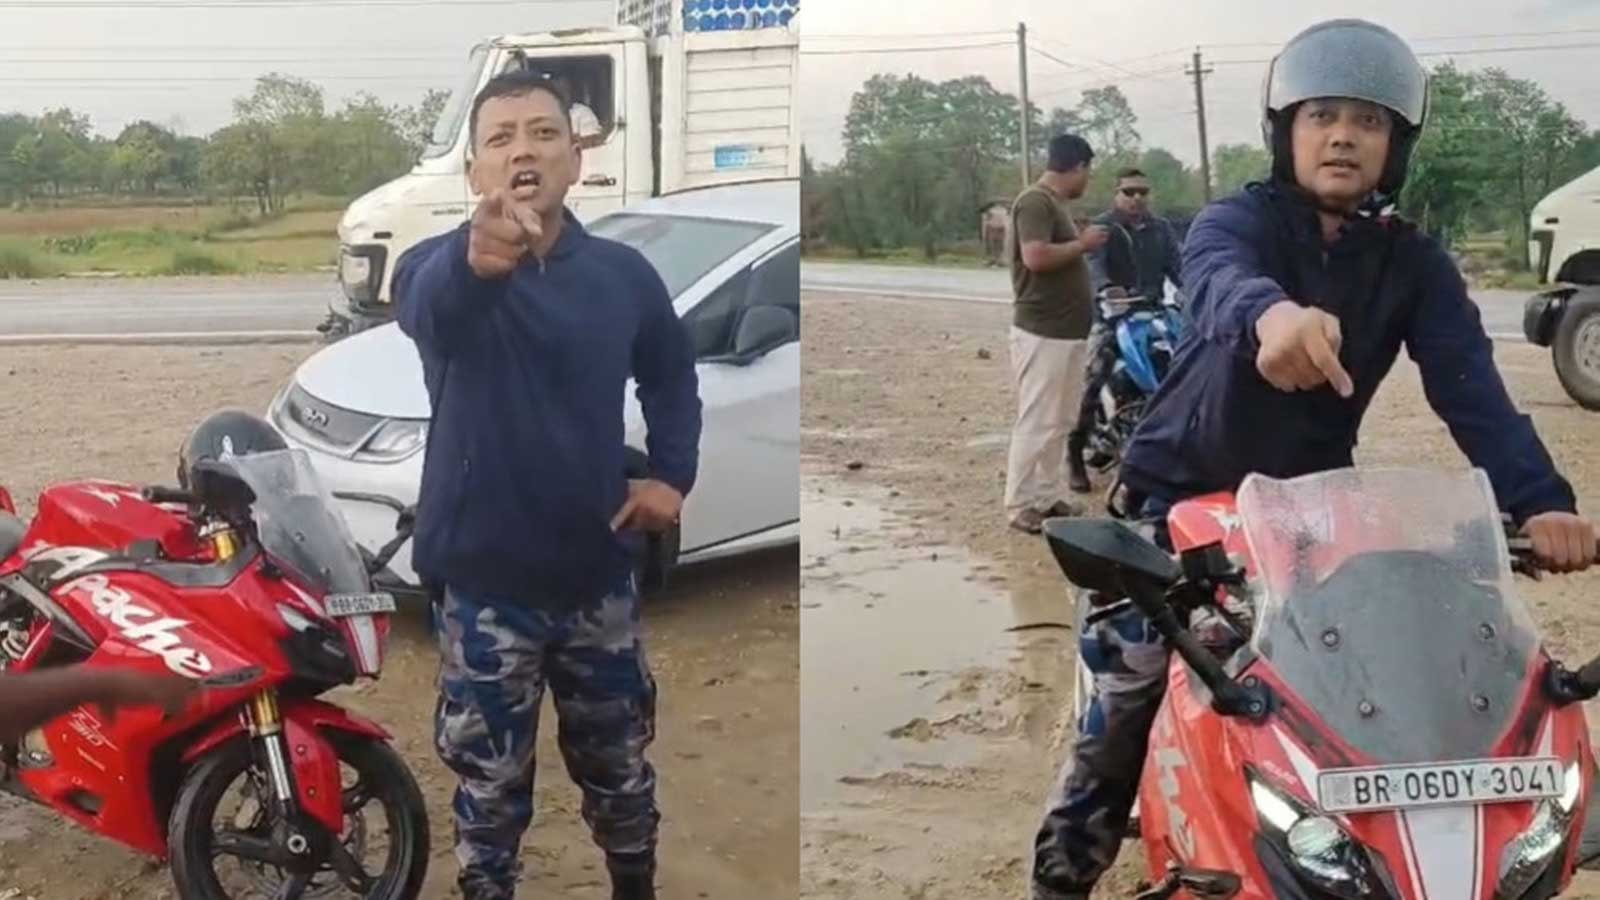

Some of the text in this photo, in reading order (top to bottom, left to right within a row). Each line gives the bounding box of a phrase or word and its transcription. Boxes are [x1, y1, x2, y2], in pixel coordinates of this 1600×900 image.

[1354, 765, 1558, 804] BR 06DY 3041
